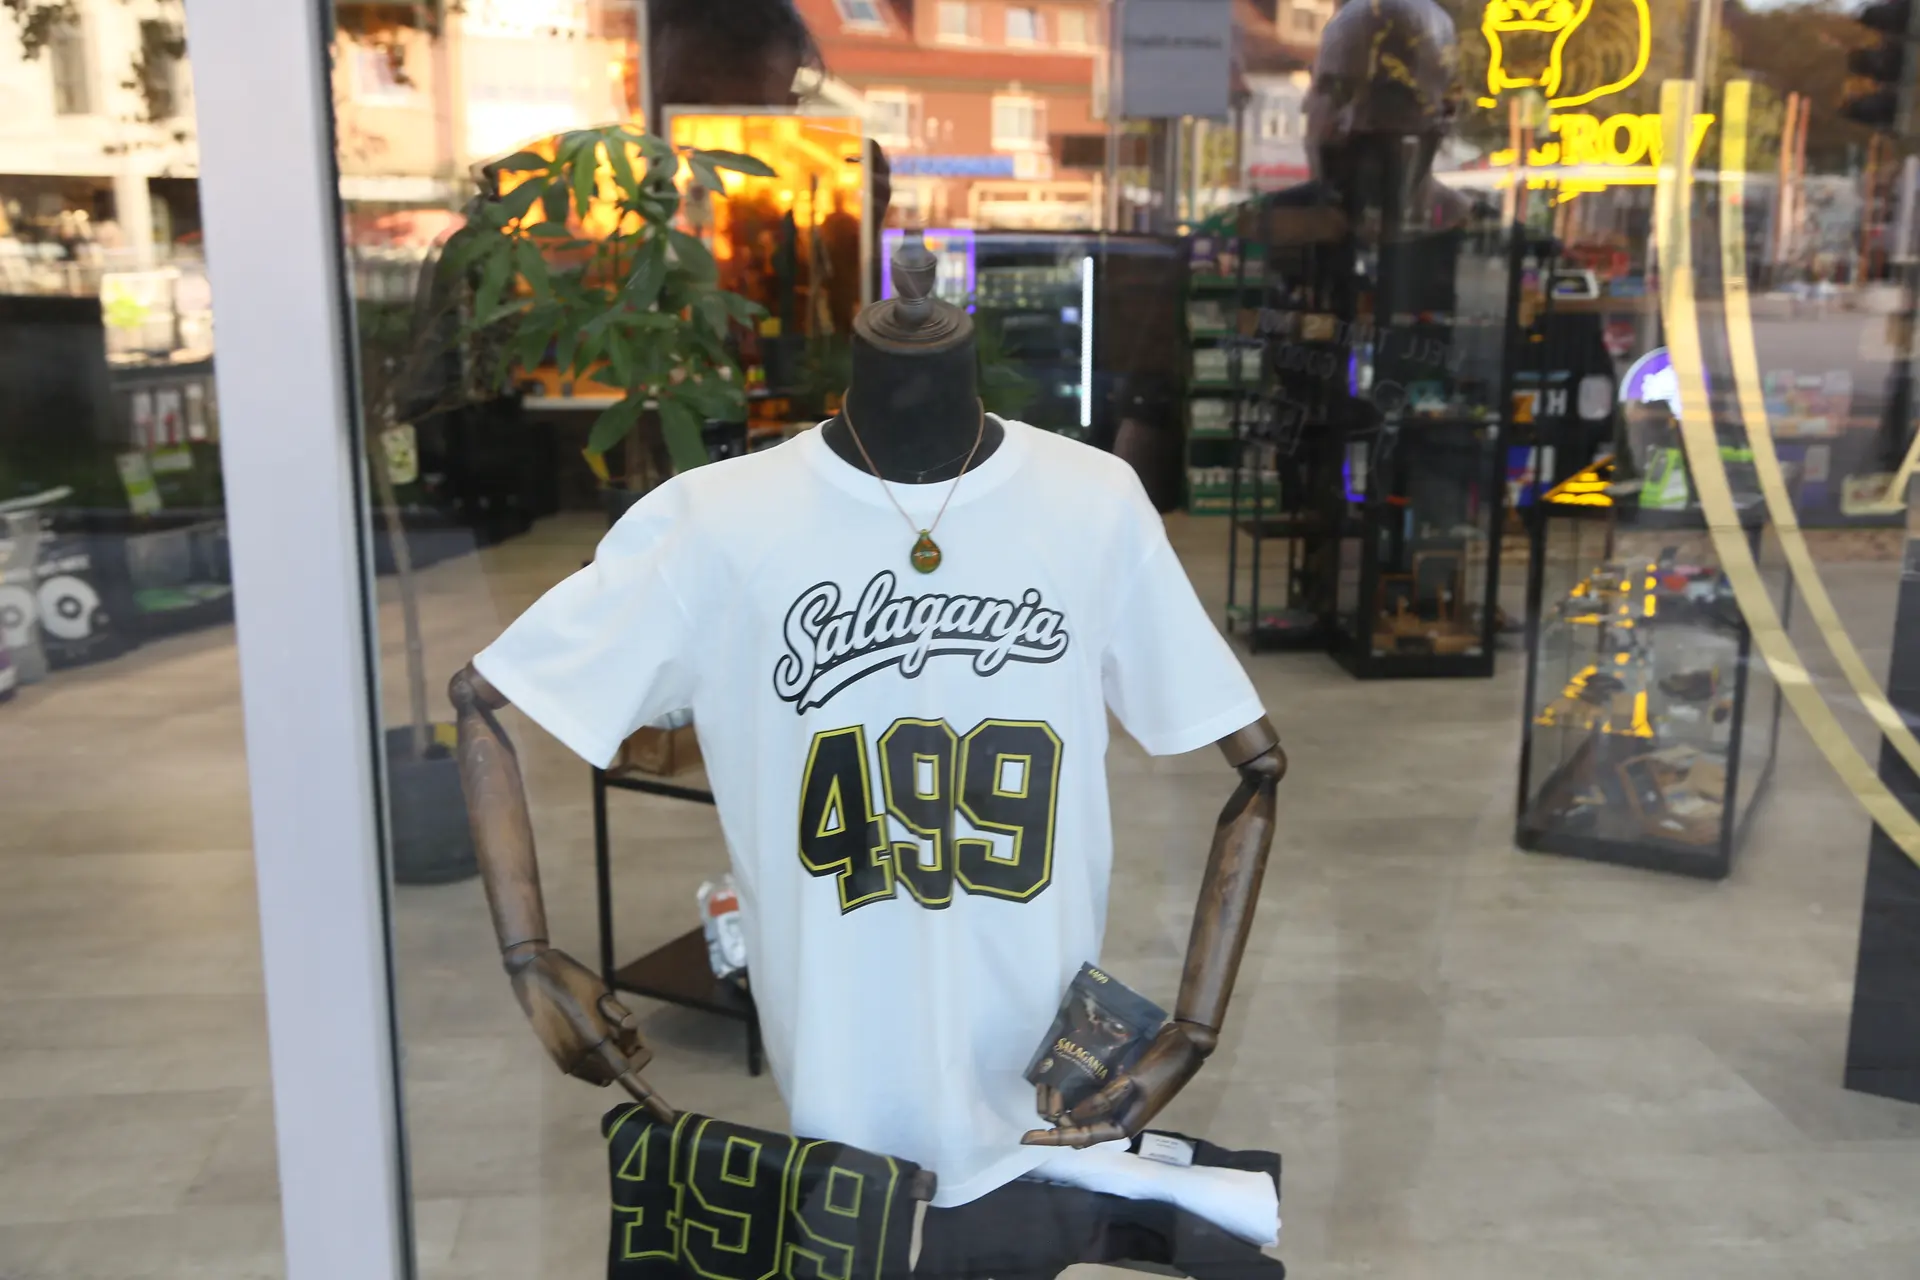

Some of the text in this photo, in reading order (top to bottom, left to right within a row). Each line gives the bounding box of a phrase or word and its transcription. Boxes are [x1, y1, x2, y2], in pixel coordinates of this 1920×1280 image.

[774, 569, 1069, 715] Salaganja
[798, 717, 1064, 915] 499
[607, 1104, 899, 1280] 499
